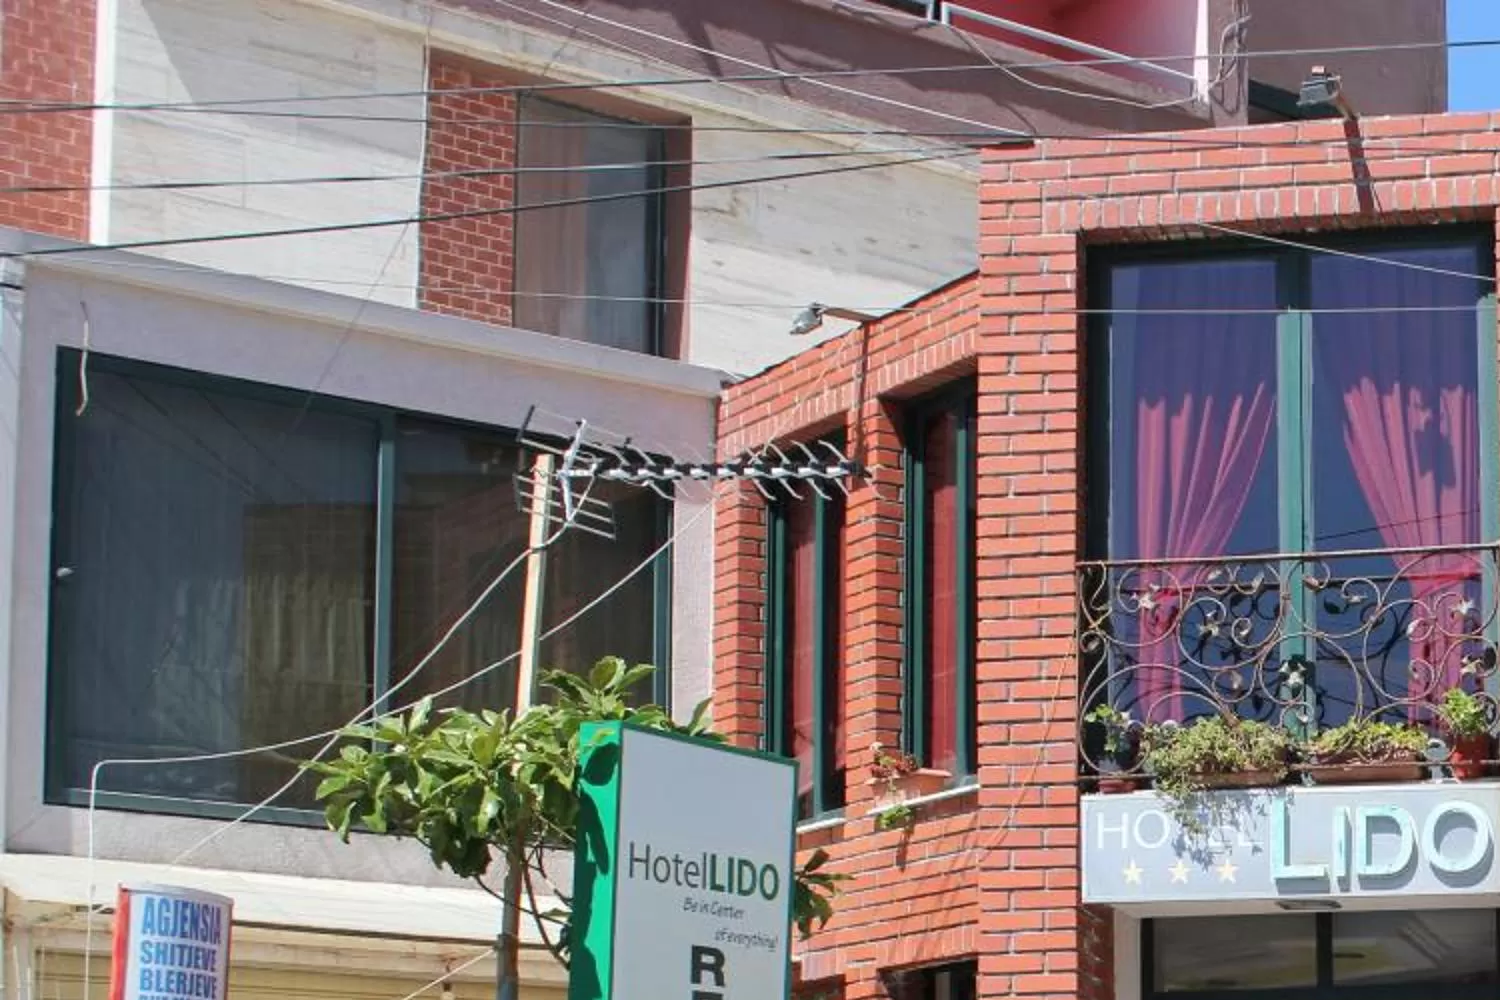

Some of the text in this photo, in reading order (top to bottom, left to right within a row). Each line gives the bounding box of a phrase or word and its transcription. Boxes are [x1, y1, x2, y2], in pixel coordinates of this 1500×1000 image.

[1271, 797, 1494, 882] LIDO
[141, 896, 221, 945] AGJENSIA
[139, 940, 217, 972] SHITJEVE
[138, 967, 217, 1000] BLERJEVE
